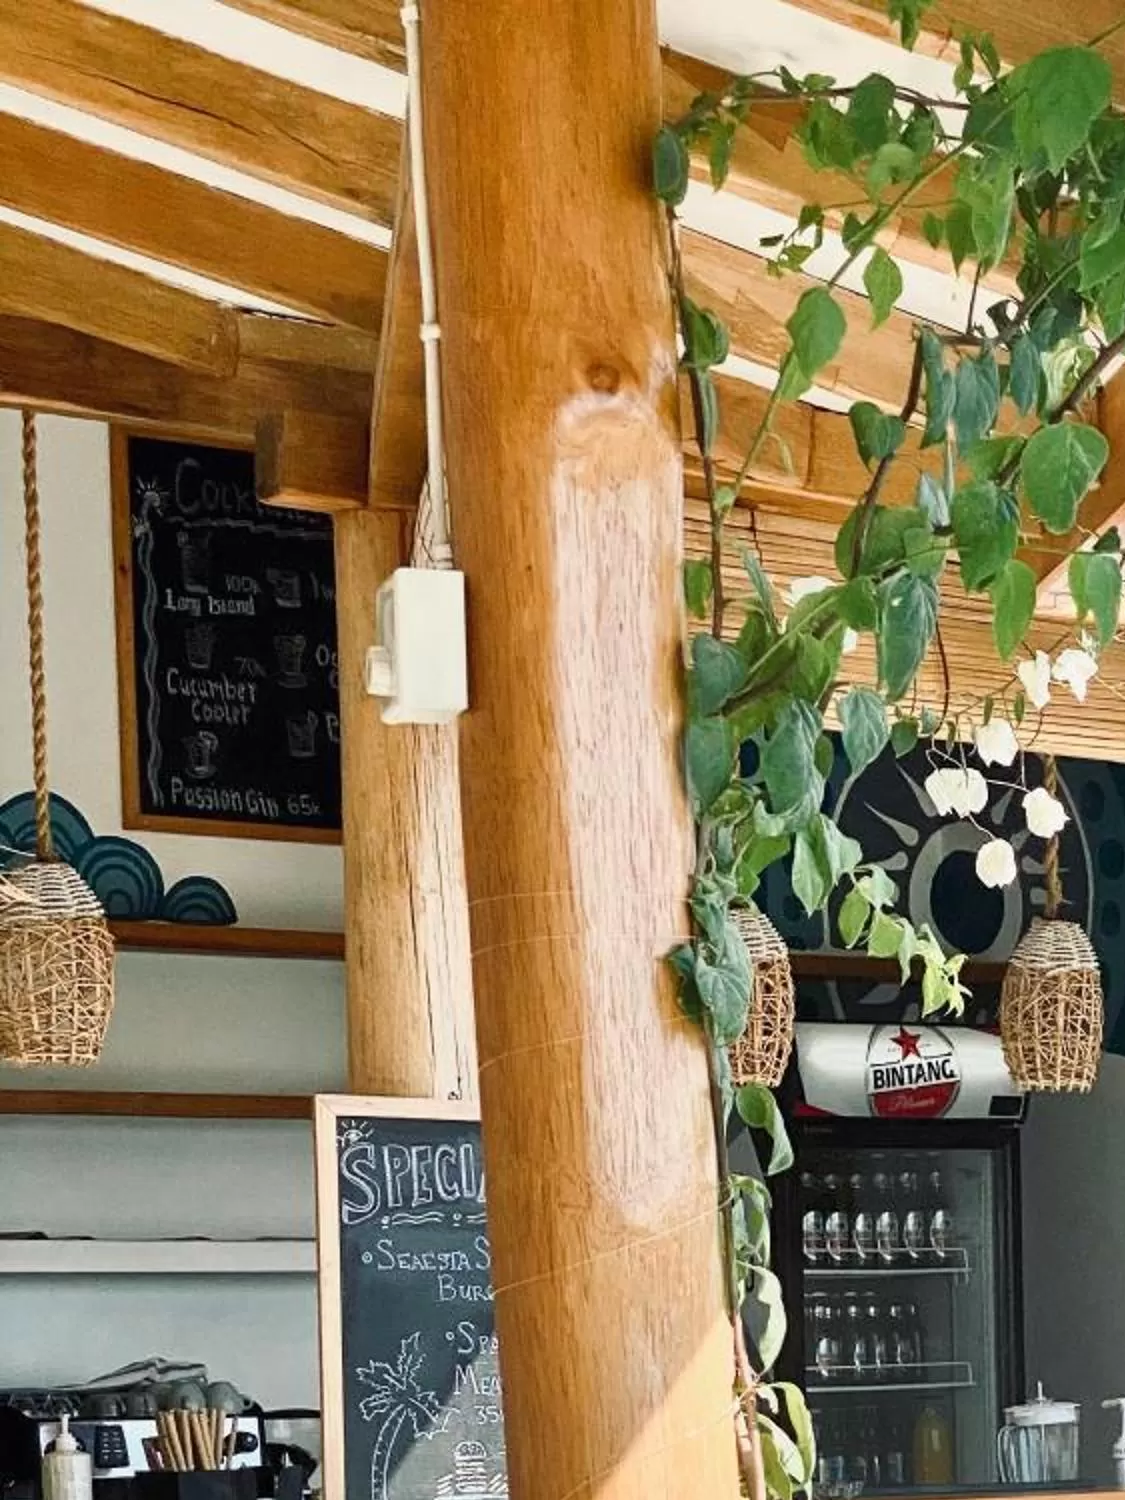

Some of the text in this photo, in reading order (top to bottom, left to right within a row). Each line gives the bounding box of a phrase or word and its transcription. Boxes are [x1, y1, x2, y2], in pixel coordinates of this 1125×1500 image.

[166, 667, 257, 703] Cucumber
[191, 699, 251, 726] Cooler
[873, 1059, 955, 1090] BINTANG
